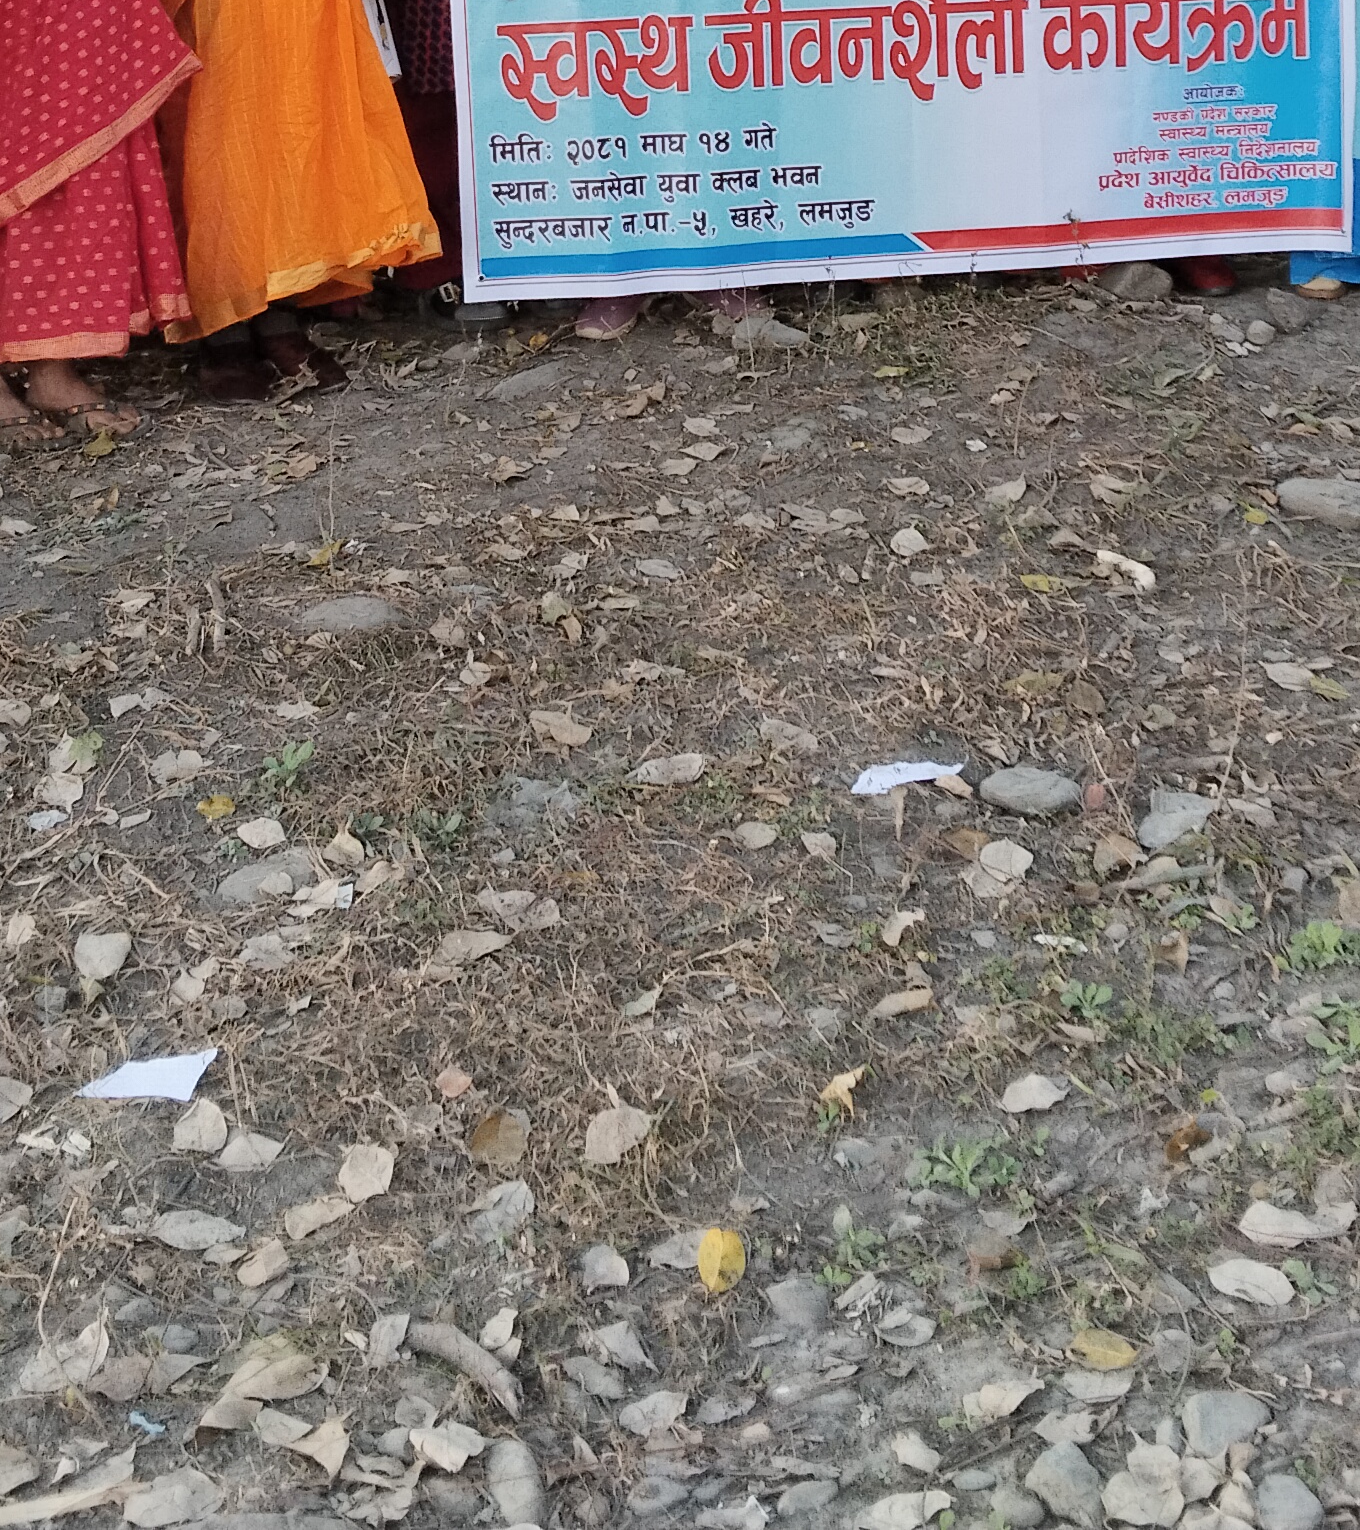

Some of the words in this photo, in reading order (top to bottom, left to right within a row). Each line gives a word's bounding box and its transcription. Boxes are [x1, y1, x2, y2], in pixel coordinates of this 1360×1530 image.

[497, 15, 693, 121] स्वस्थ
[1201, 105, 1227, 121] प्रदेश
[1234, 104, 1277, 119] सरकार
[567, 137, 627, 165] २०८१
[641, 132, 687, 157] माघ
[698, 130, 731, 155] १४
[743, 122, 778, 150] गते
[1159, 125, 1207, 142] स्वास्थ्य
[1214, 123, 1270, 138] मन्त्रालय
[1113, 146, 1170, 166] प्रादेशिक
[1178, 144, 1231, 161] स्वास्थ्य
[571, 171, 647, 201] जनसेवा
[657, 172, 700, 202] युवा
[711, 168, 761, 193] क्लब
[771, 165, 822, 189] भवन
[1098, 170, 1141, 191] प्रदेश
[1148, 165, 1212, 188] आयुर्वेद
[1220, 161, 1337, 182] चिकित्सालय
[1224, 187, 1287, 206] लमजुङ
[494, 217, 612, 248] सुन्दरबजार
[798, 199, 875, 227] लमजुङ
